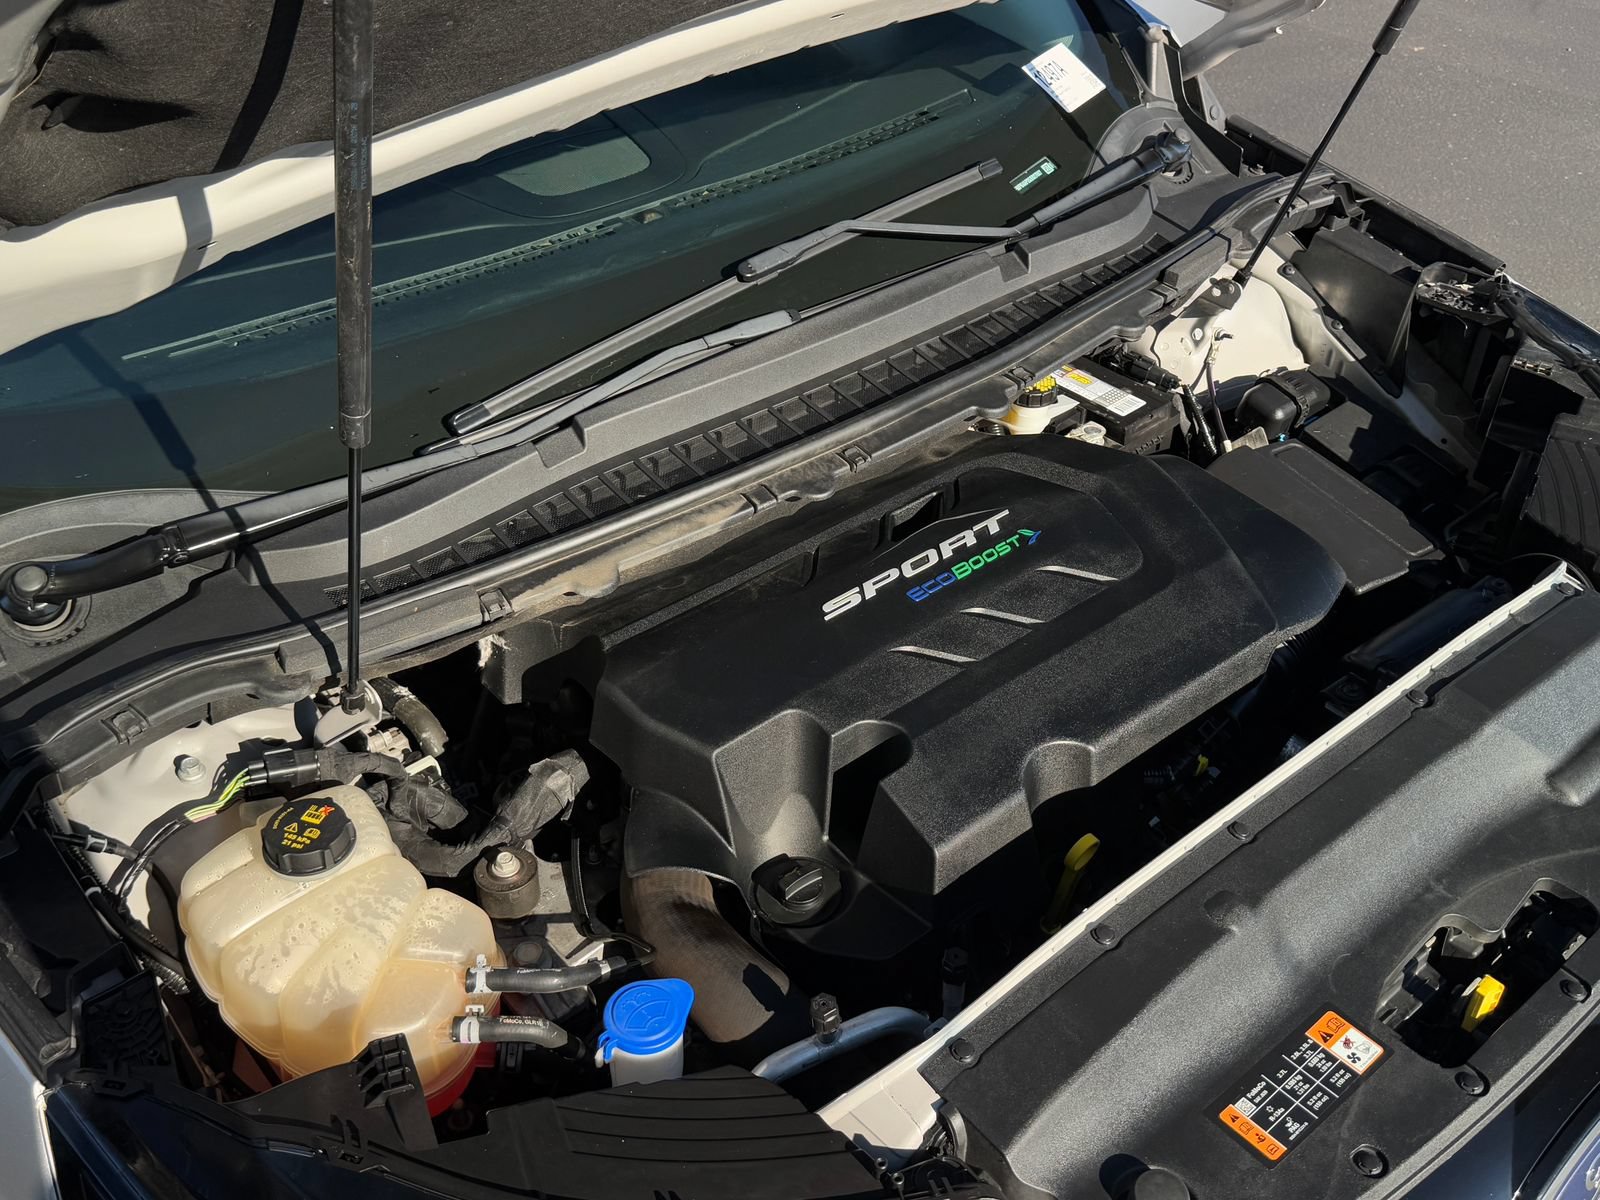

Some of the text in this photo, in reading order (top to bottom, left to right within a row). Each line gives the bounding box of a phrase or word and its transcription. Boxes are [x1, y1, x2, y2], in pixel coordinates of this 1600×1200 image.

[822, 509, 1010, 622] SPORT
[906, 534, 1020, 602] ECOBOOST
[1247, 1081, 1266, 1099] FoMoCo
[1288, 1122, 1300, 1133] PAG
